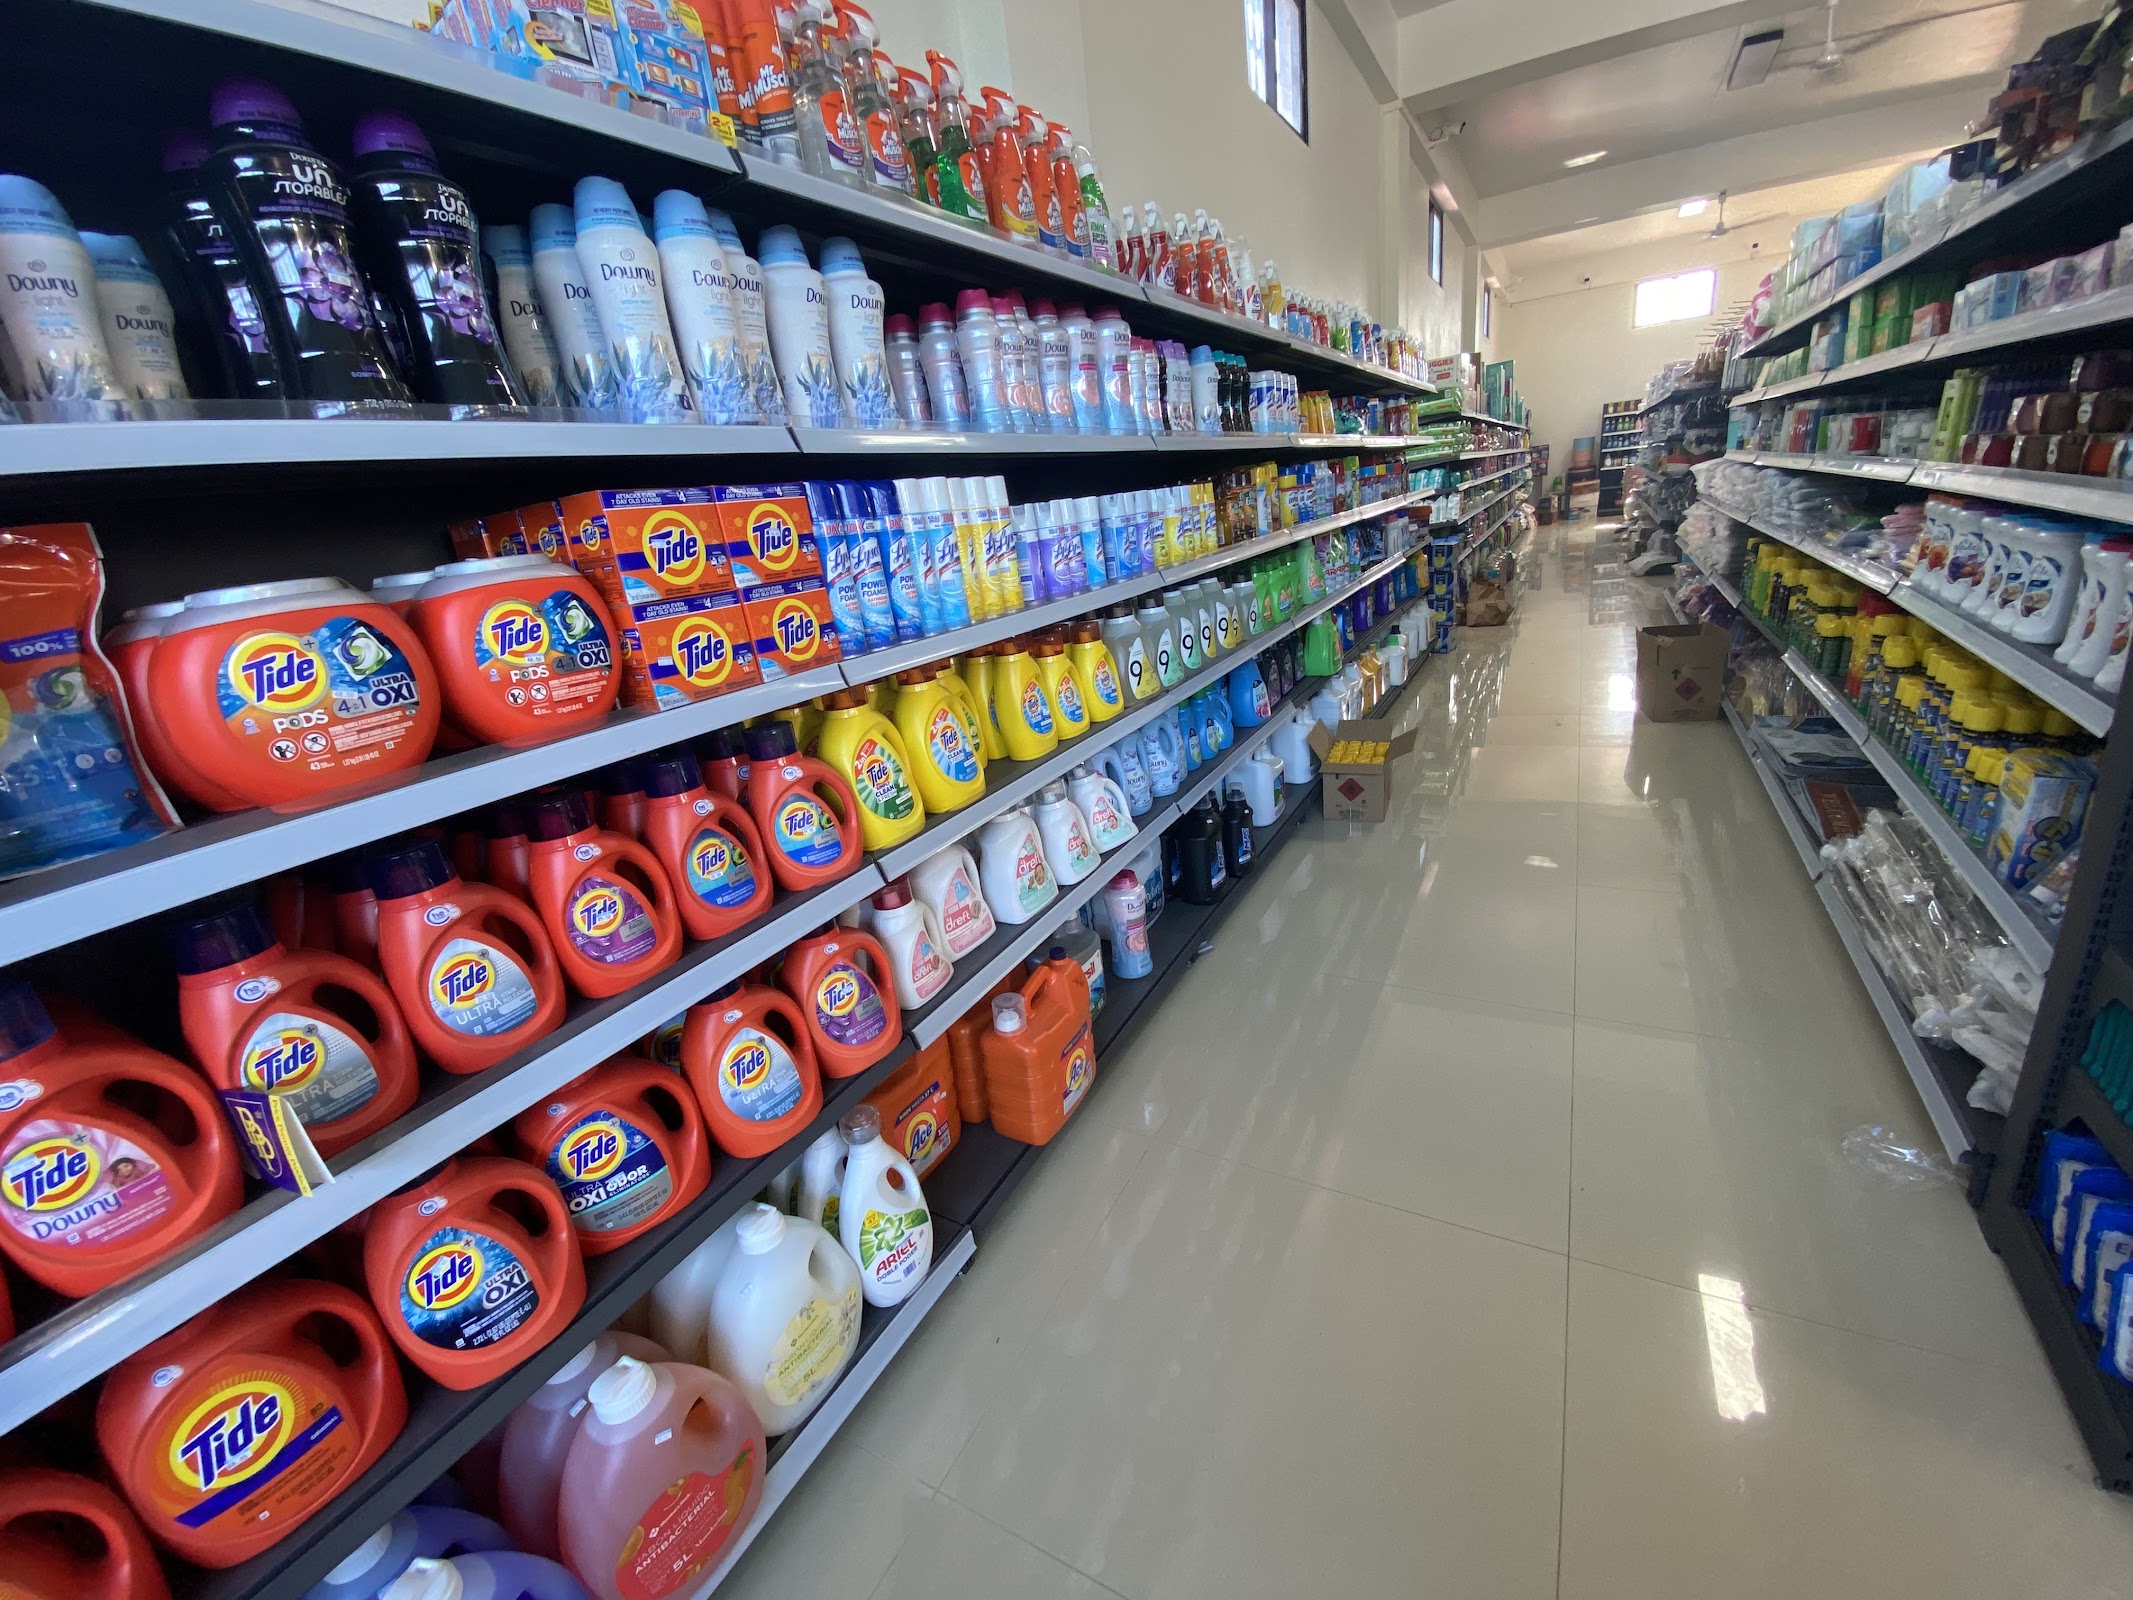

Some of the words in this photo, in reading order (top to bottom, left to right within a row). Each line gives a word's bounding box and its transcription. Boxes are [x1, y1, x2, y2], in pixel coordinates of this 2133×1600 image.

[760, 64, 775, 79] Mr
[7, 273, 78, 298] Downy
[600, 262, 657, 288] Downy
[116, 314, 169, 337] Downy
[581, 525, 598, 545] Tide
[648, 527, 699, 577] Tide
[646, 605, 671, 613] ATTACKS
[670, 601, 686, 609] EVEN
[1249, 611, 1257, 629] 9
[491, 615, 543, 659] Tide
[776, 612, 815, 656] Tide
[1201, 625, 1211, 649] 9
[1218, 617, 1228, 640] 9
[578, 648, 609, 668] OXI
[579, 641, 605, 652] ULTRA
[677, 631, 726, 681] Tide
[1182, 634, 1194, 659] 9
[1130, 660, 1142, 687] 9
[1158, 649, 1169, 675] 9
[241, 650, 317, 704] Tide
[371, 673, 408, 689] ULTRA
[371, 681, 416, 707] OXI
[940, 726, 958, 752] Tide
[947, 749, 963, 760] CLEAN
[866, 762, 889, 788] Tide
[875, 784, 895, 798] CLEAN
[784, 810, 815, 839] Tide
[1093, 810, 1114, 824] dreft
[696, 847, 727, 879] Tide
[1018, 854, 1042, 875] dreft
[579, 897, 618, 933] Tide
[945, 910, 971, 931] dreft
[439, 962, 488, 1007] Tide
[823, 978, 856, 1013] Tide
[455, 997, 503, 1025] ULTRA
[255, 1040, 317, 1091] Tide
[728, 1048, 765, 1088] Tide
[291, 1079, 335, 1110] LTRA
[909, 1122, 933, 1159] Ace
[567, 1132, 617, 1181] Tide
[9, 1149, 88, 1211] Tide
[565, 1181, 603, 1201] ULTRA
[609, 1172, 650, 1197] ELIMINATORS
[569, 1187, 607, 1212] OXI
[31, 1192, 123, 1240] Downy
[875, 1238, 917, 1277] ARIEL
[876, 1263, 900, 1283] DOBLE
[898, 1245, 919, 1268] PODER
[415, 1252, 473, 1311] Tide
[485, 1263, 519, 1288] ULTRA
[485, 1269, 526, 1304] OXI
[778, 1317, 834, 1378] ANTIBACTERIAL
[178, 1392, 281, 1492] Tide
[634, 1528, 672, 1567] JABON
[672, 1484, 711, 1529] LIQUIDO
[635, 1490, 716, 1575] ANTIBACTERIAL
